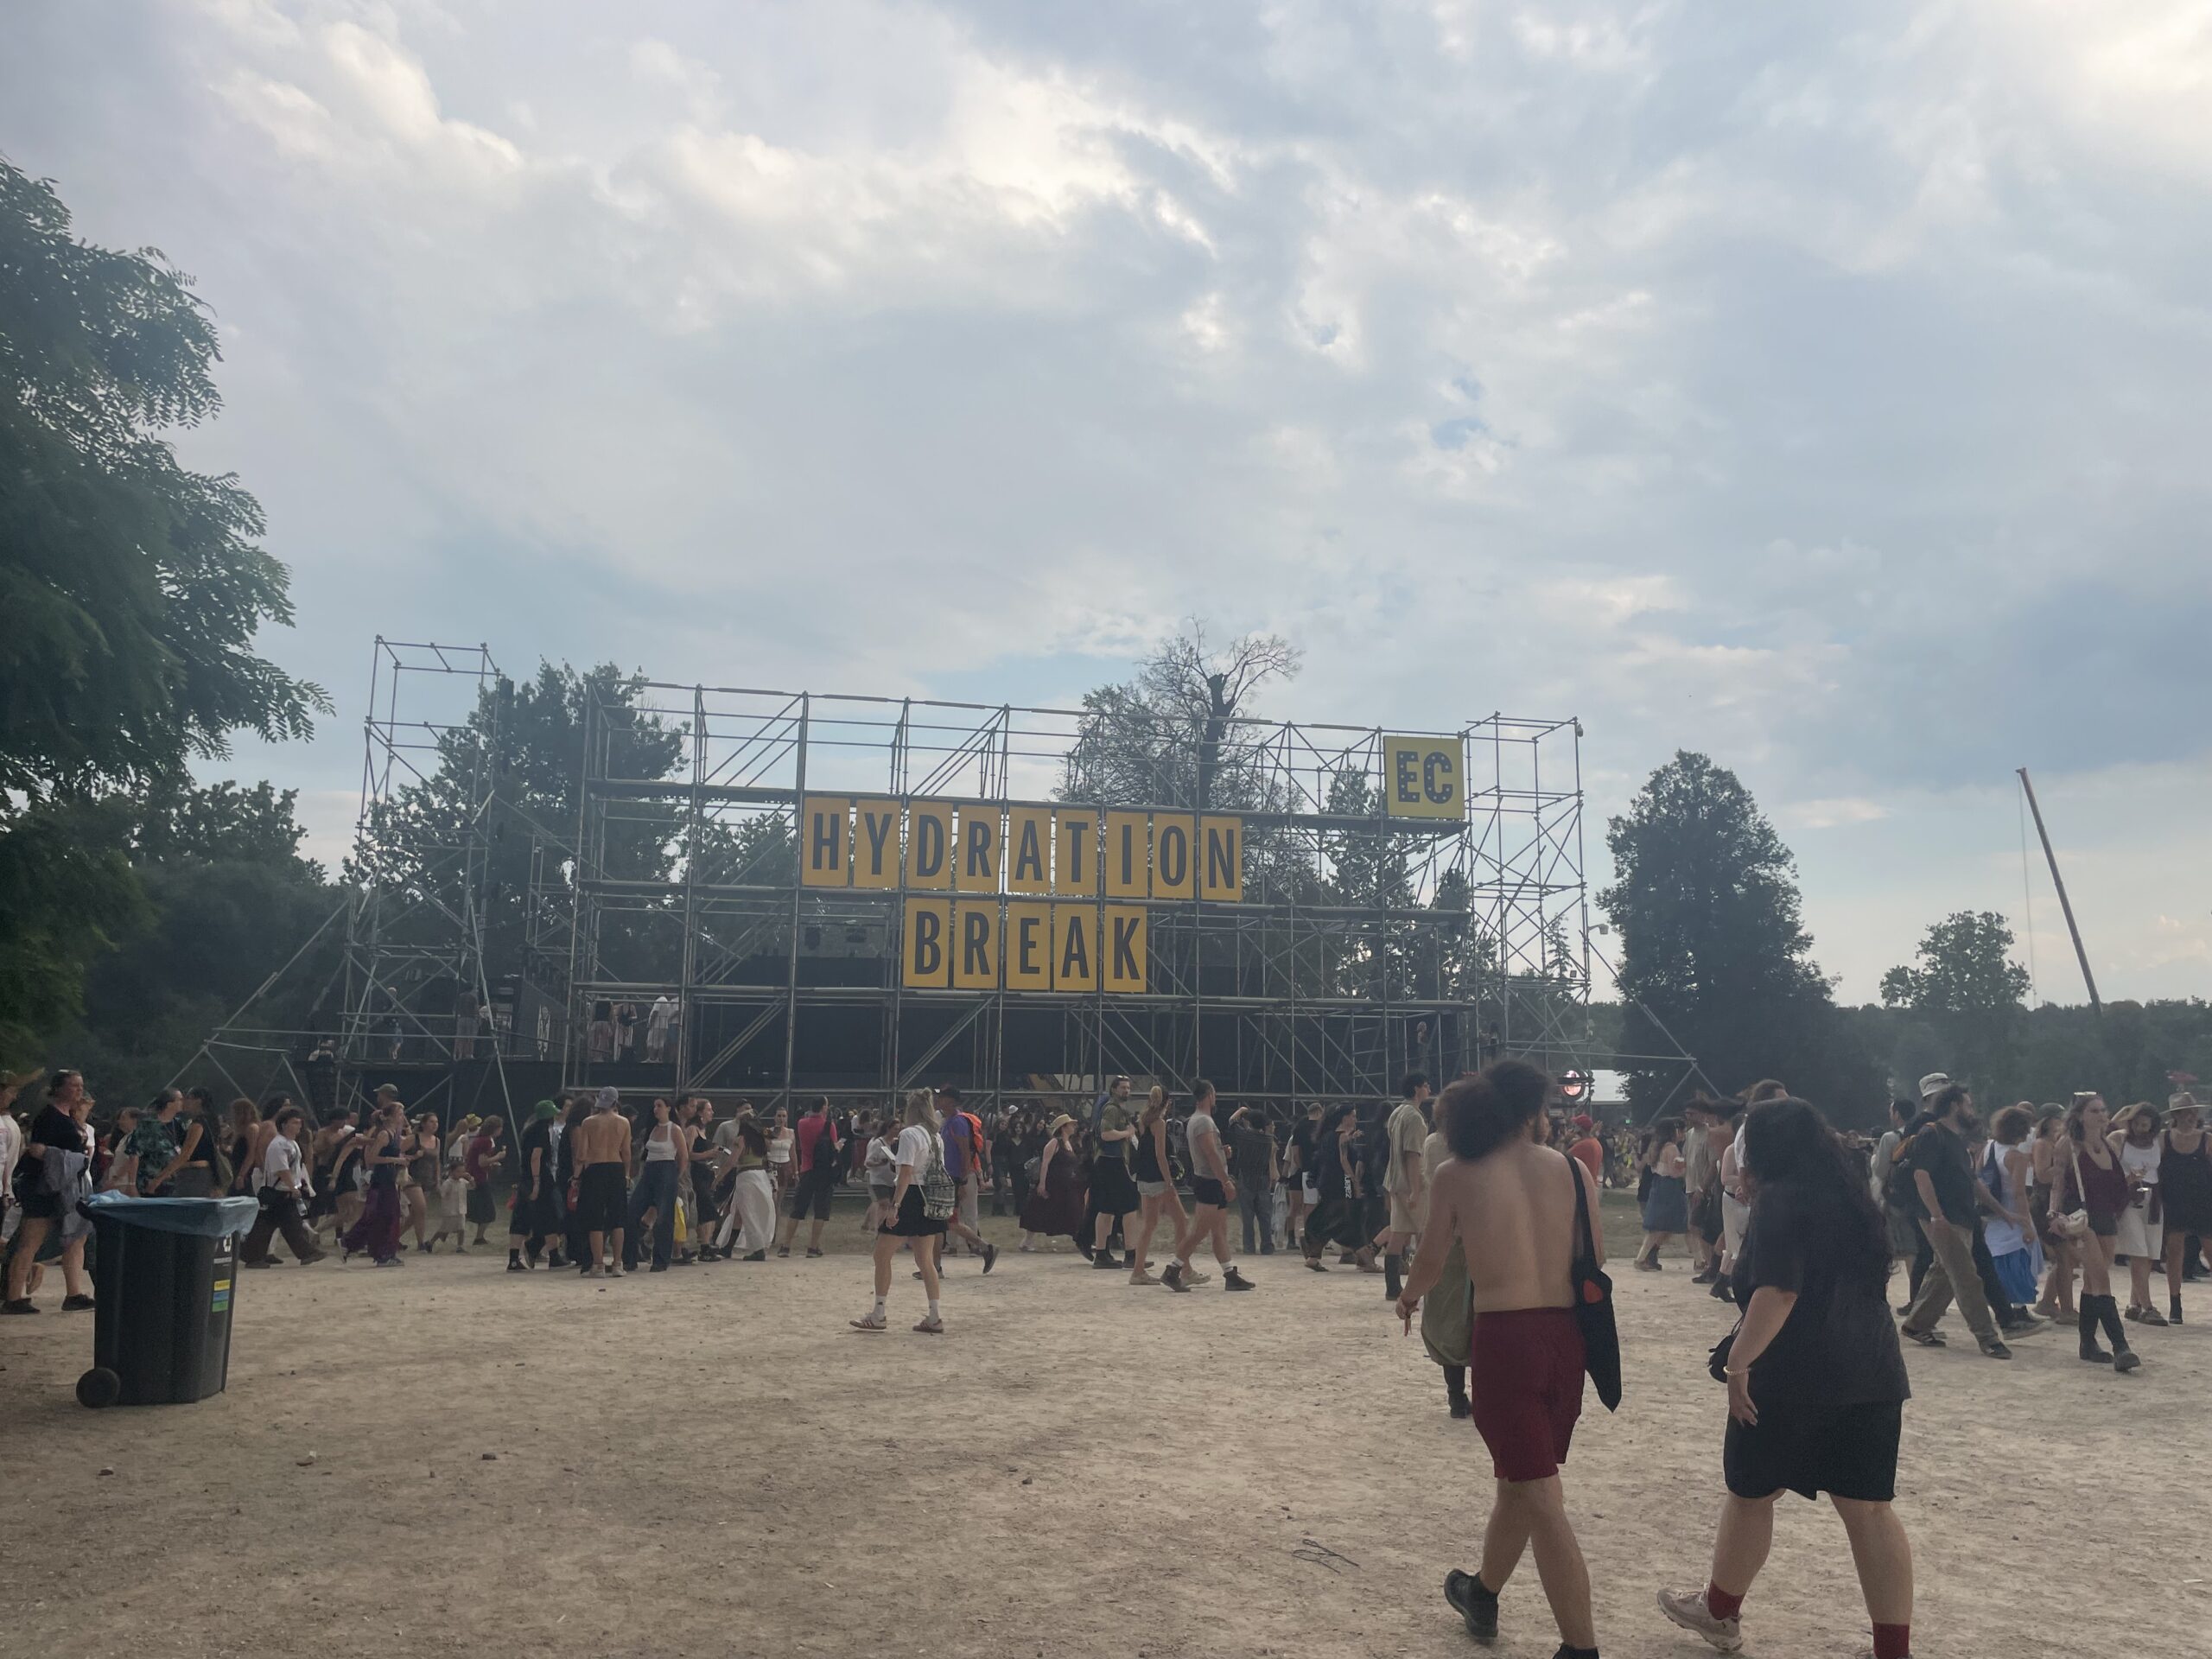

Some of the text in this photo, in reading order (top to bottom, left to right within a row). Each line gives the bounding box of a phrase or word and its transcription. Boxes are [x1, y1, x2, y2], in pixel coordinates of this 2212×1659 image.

[1396, 750, 1453, 804] EC
[811, 812, 1236, 889] HYDRATION
[913, 911, 1141, 981] BREAK
